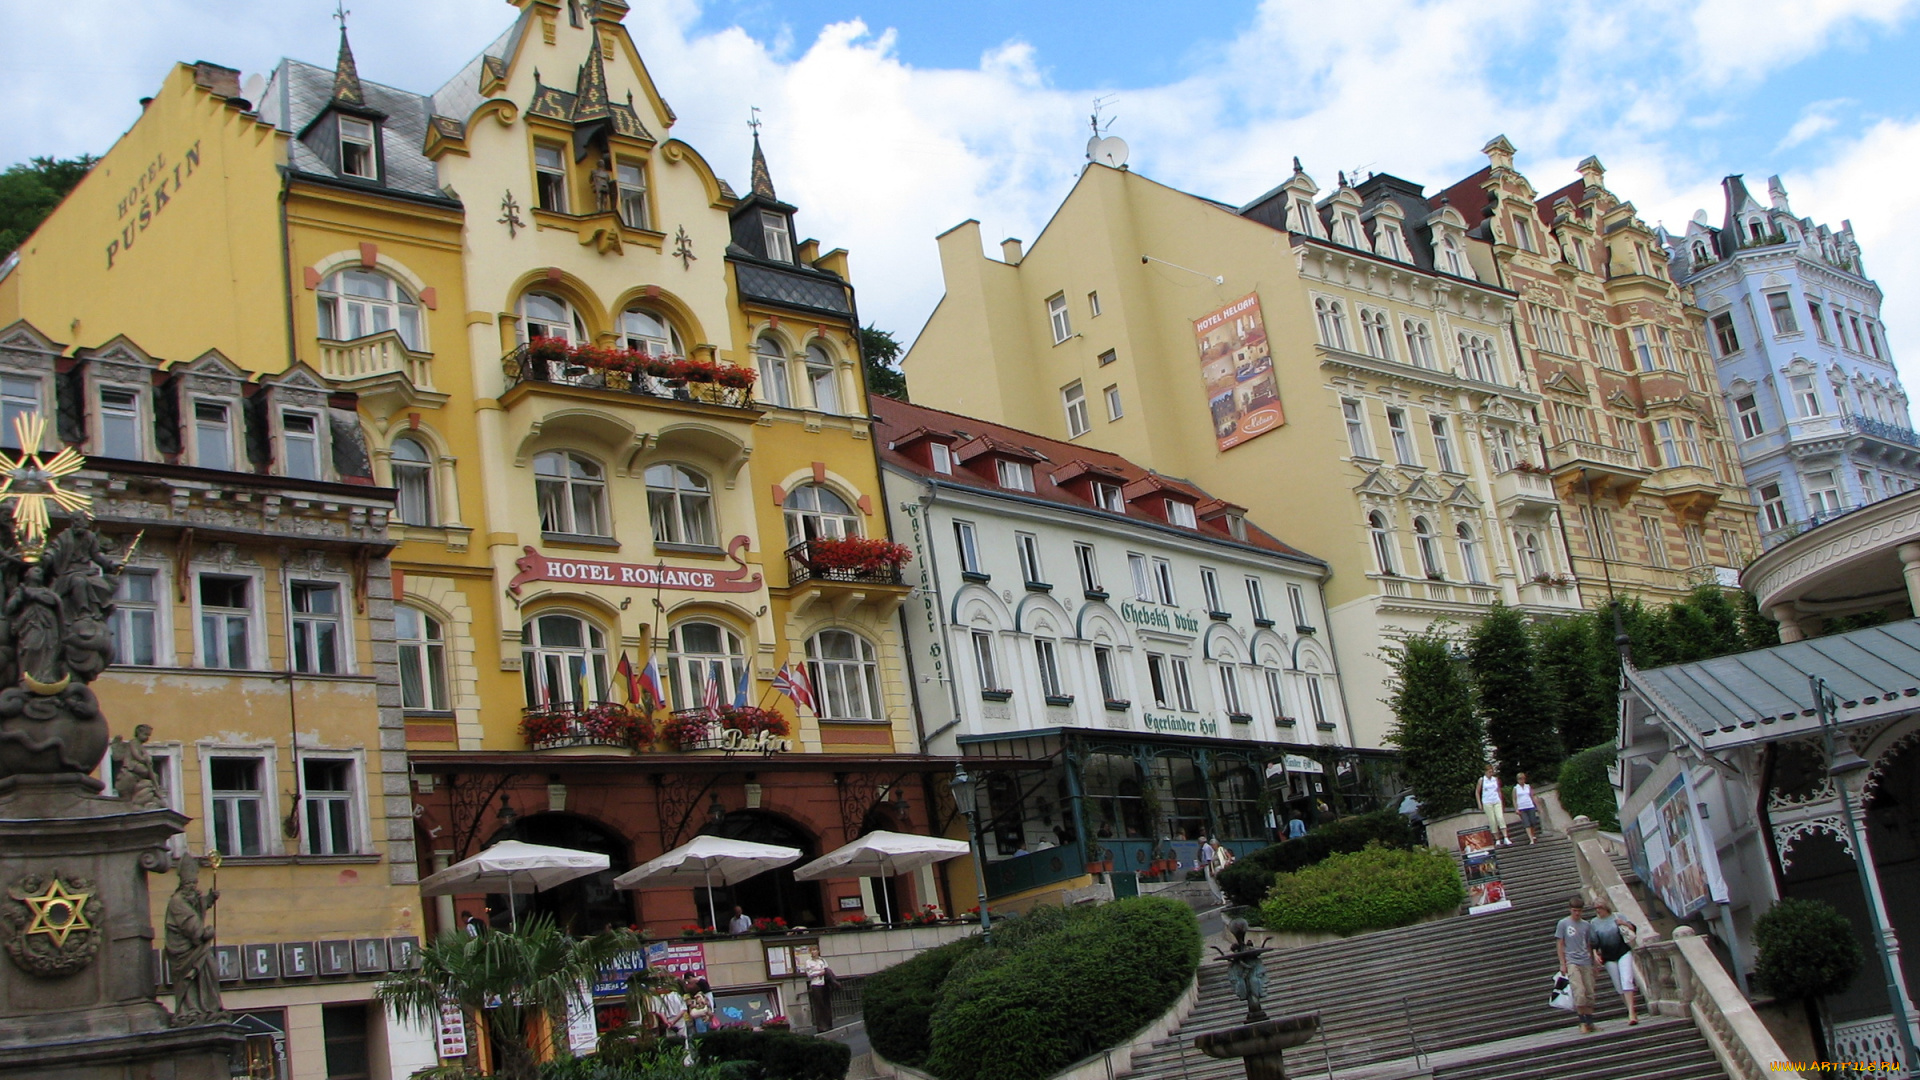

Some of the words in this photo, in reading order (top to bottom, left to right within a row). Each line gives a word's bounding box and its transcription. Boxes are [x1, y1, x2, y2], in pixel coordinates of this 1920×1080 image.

[117, 152, 166, 221] HOTEL
[106, 139, 201, 271] PUŠKIN
[1196, 314, 1222, 333] HOTEL
[1223, 297, 1255, 320] HELUAN
[547, 561, 616, 582] HOTEL
[621, 566, 715, 588] ROMANCE
[907, 502, 936, 634] Egerländer
[929, 642, 944, 689] Hof
[1121, 601, 1171, 633] Chebský
[1143, 712, 1196, 734] Egerländer
[1199, 717, 1218, 738] Hof
